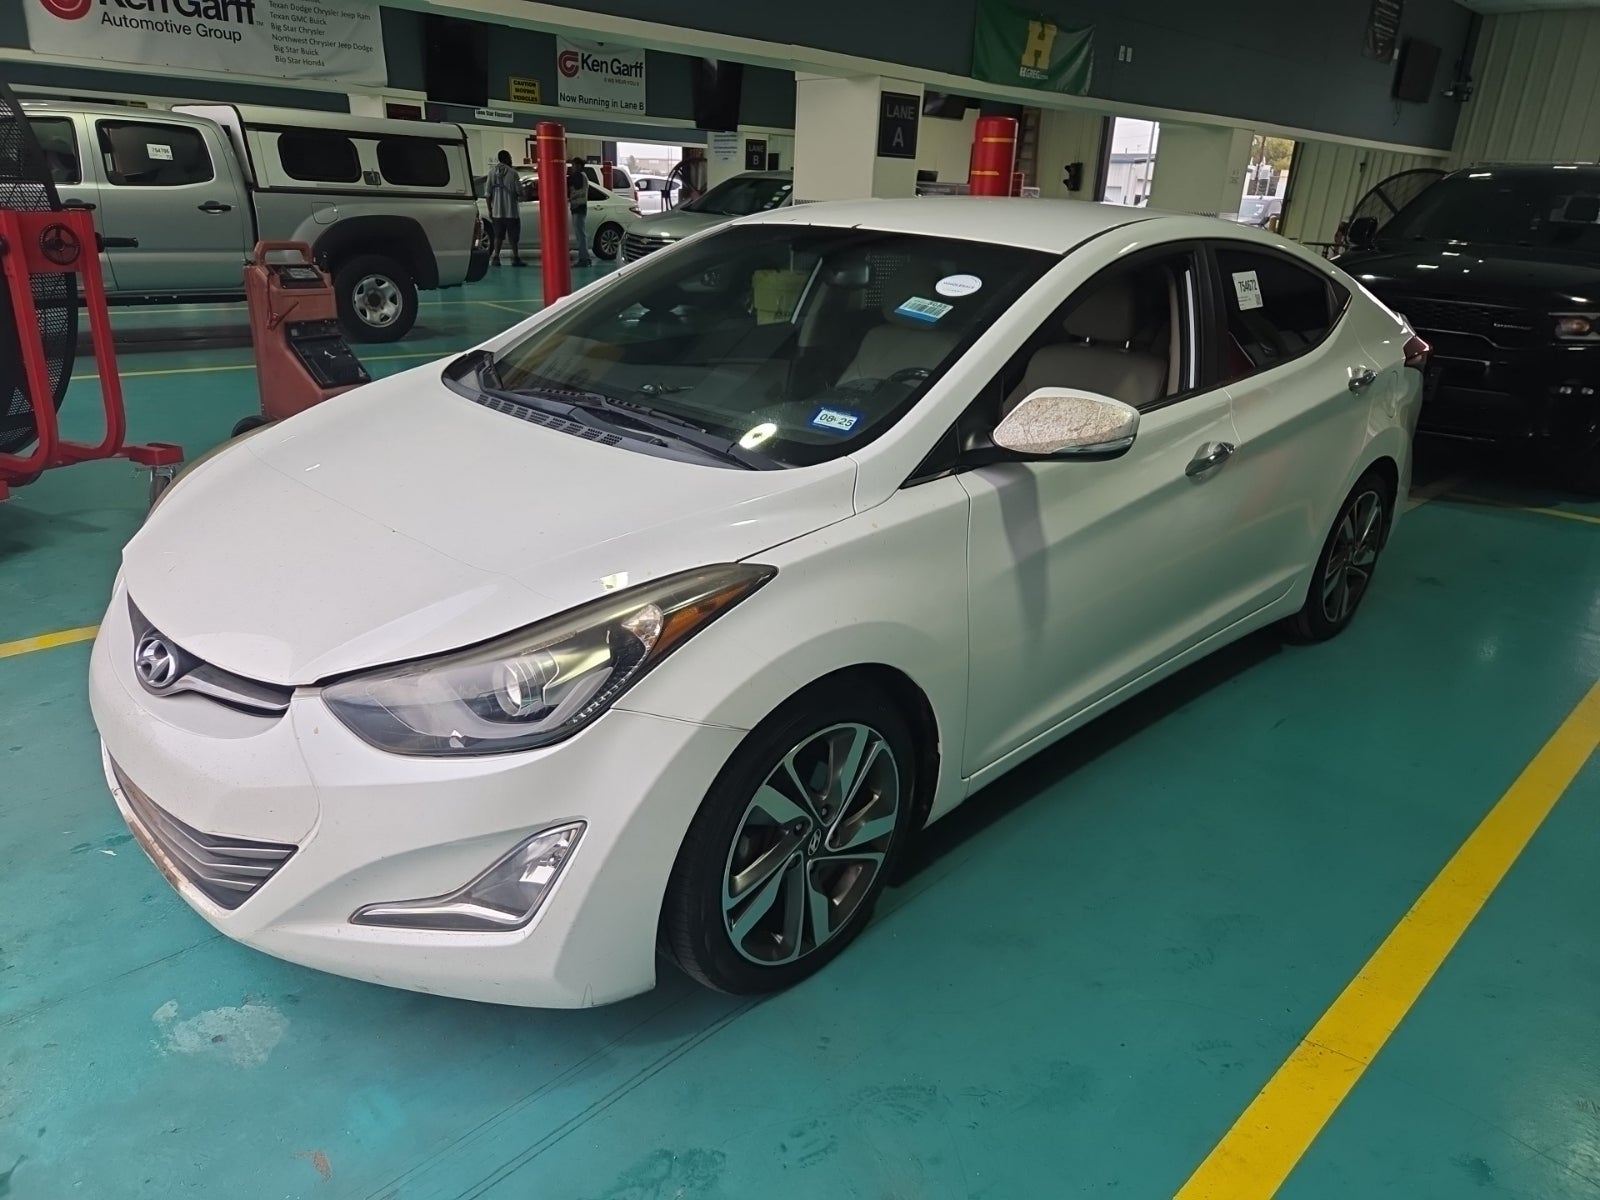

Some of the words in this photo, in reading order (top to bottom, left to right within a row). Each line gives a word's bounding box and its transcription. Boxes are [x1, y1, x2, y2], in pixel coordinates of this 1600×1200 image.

[101, 12, 192, 35] Automotive
[196, 23, 242, 44] Group
[309, 17, 327, 26] Buick
[298, 26, 325, 36] Chrysler
[272, 34, 308, 44] Northwest
[309, 38, 336, 48] Chrysler
[286, 45, 300, 54] Star
[301, 47, 319, 55] Buick
[288, 56, 301, 65] Star
[581, 53, 608, 73] Ken
[611, 58, 643, 78] Garff
[560, 92, 576, 103] Now
[578, 94, 610, 108] Running
[611, 99, 618, 108] in
[620, 100, 638, 110] Lane
[887, 104, 915, 120] LANE
[892, 126, 904, 148] A
[819, 413, 835, 423] 08
[838, 417, 854, 427] 25
